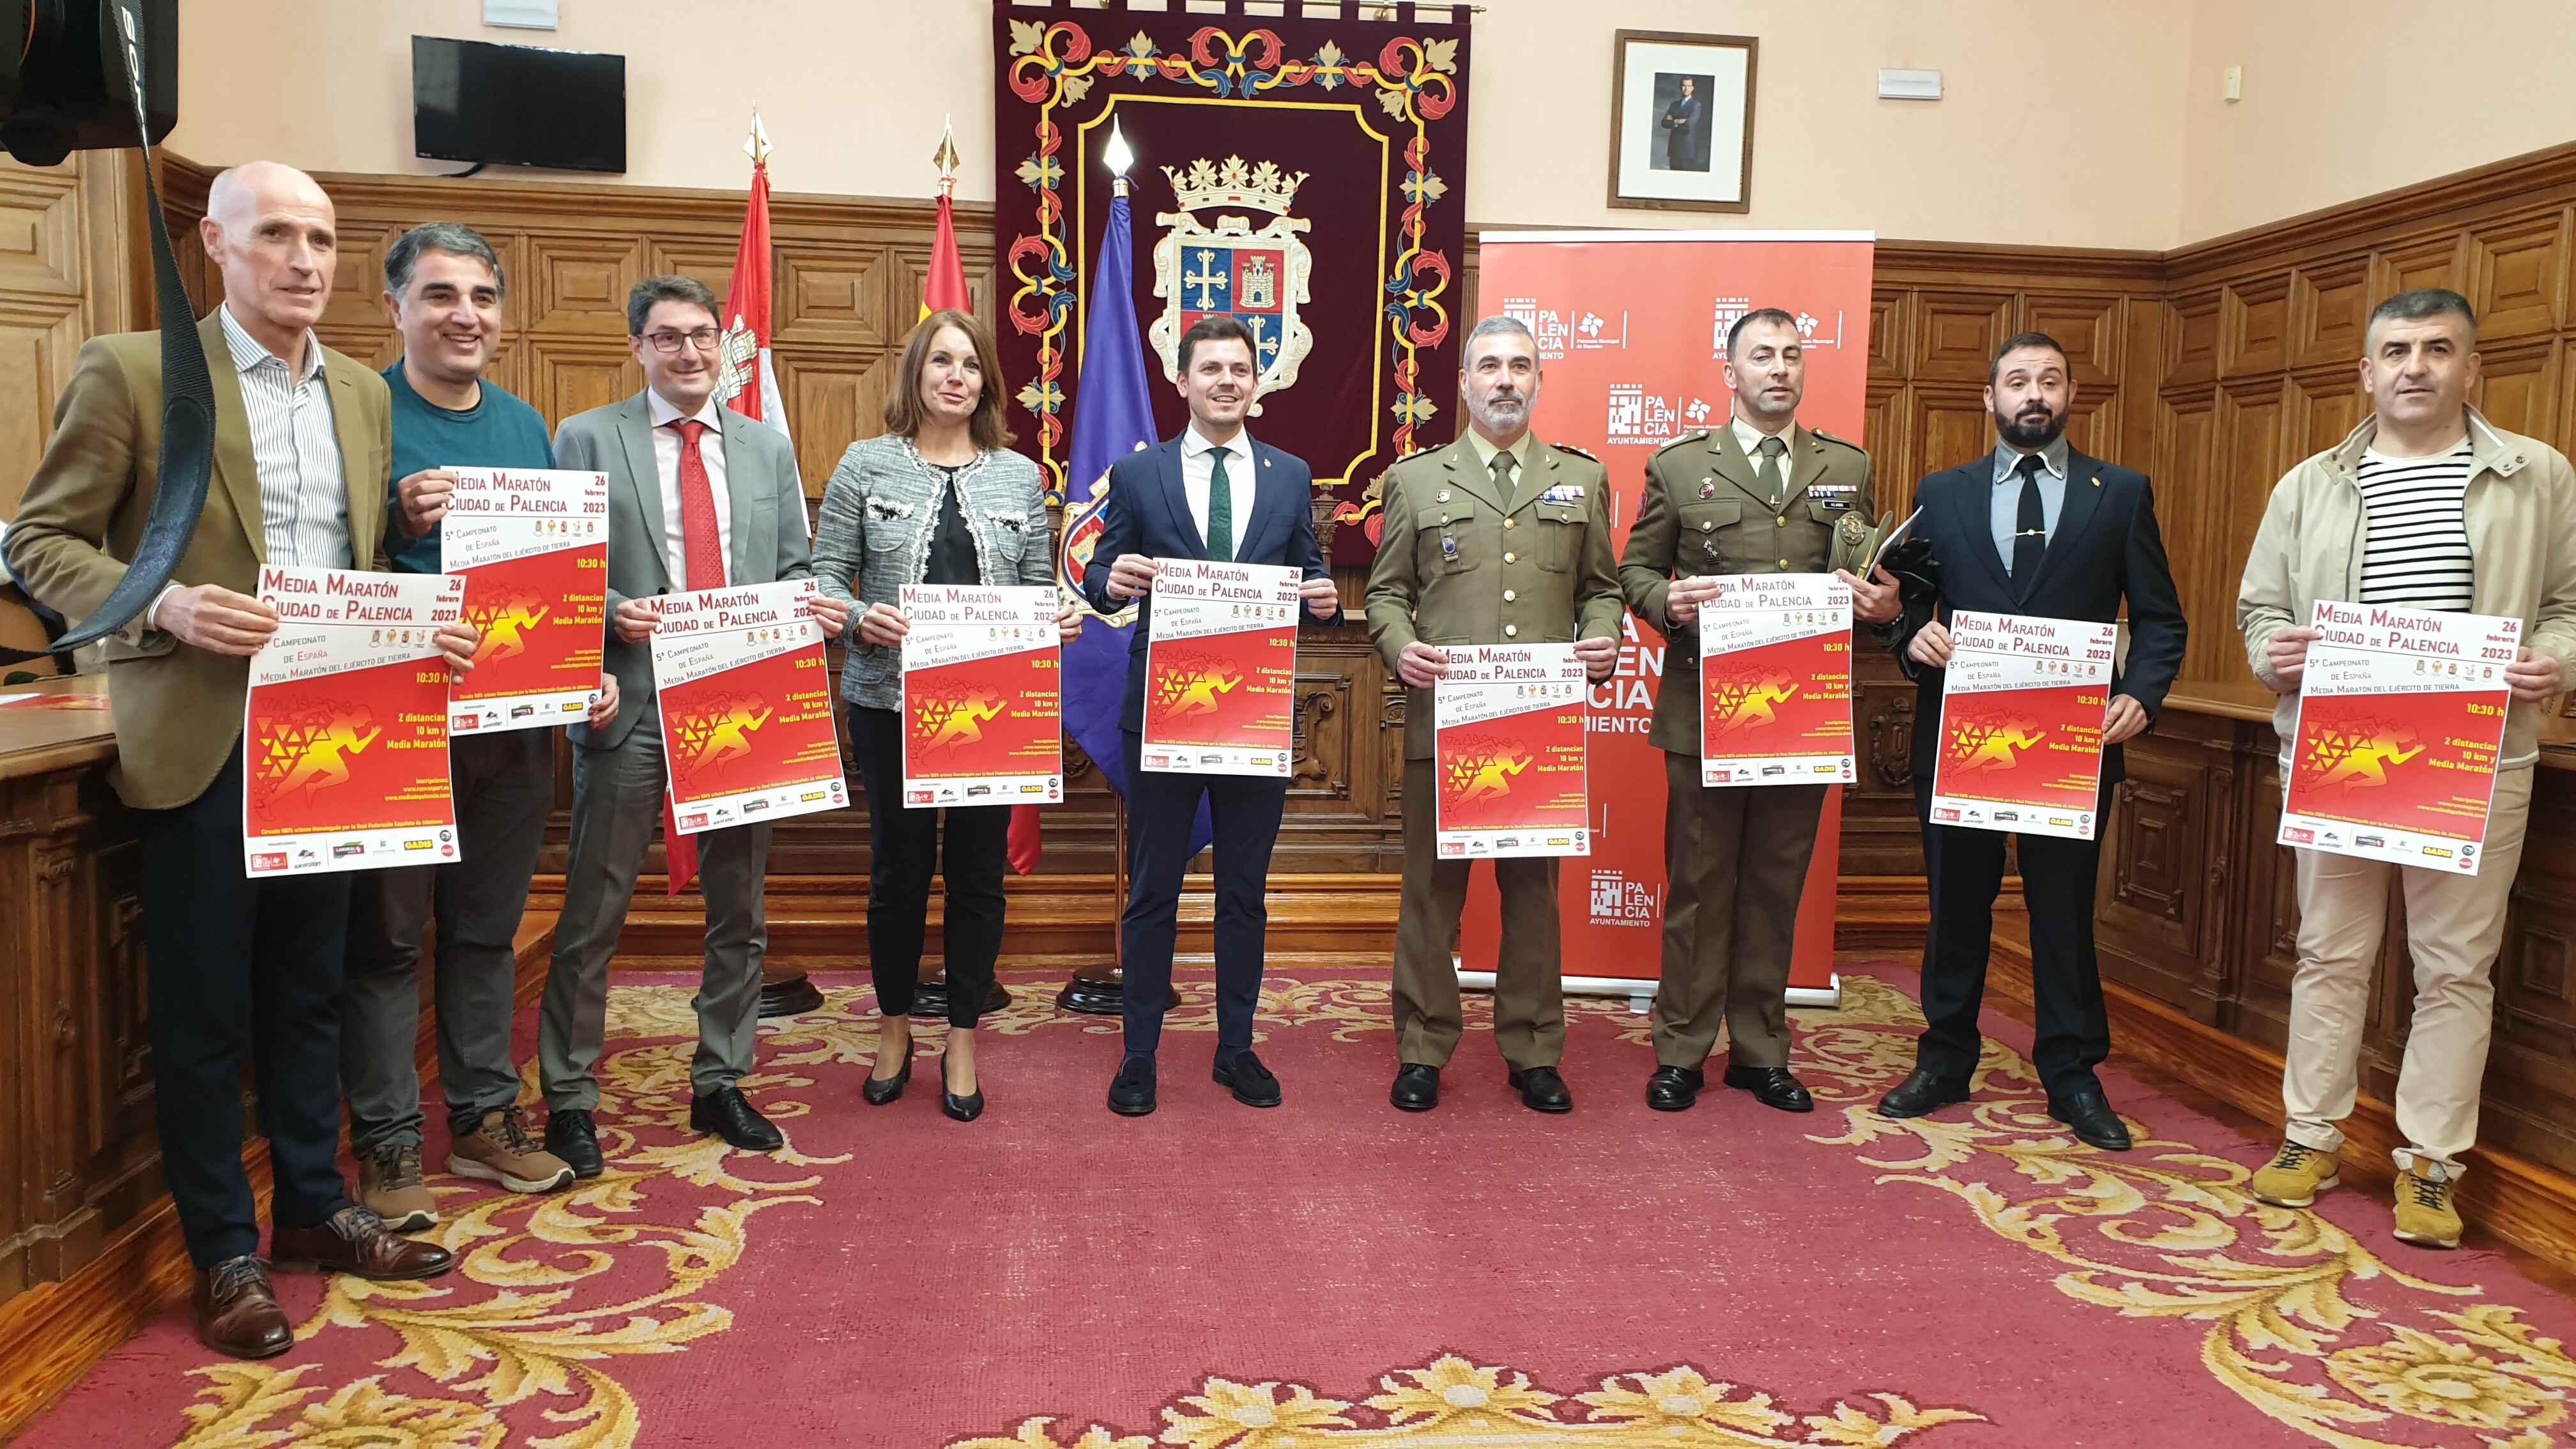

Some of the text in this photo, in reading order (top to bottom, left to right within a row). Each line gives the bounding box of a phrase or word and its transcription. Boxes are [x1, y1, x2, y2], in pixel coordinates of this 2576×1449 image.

[1538, 310, 1559, 323] PA
[1538, 323, 1568, 337] LEN
[1537, 337, 1564, 350] CIA
[1645, 396, 1666, 409] PA
[1644, 410, 1675, 422] LEN
[1643, 422, 1671, 436] CIA
[493, 472, 550, 492] MARATÓN
[595, 475, 605, 486] 26
[495, 503, 505, 511] DE
[510, 494, 567, 512] PALENCIA
[583, 502, 605, 513] 2023
[456, 526, 496, 539] CAMPEONATO
[475, 539, 500, 549] ESPAÑA
[577, 558, 597, 568] 10:30
[1197, 564, 1248, 581] MARATÓN
[1289, 570, 1299, 579] 26
[265, 569, 399, 598] MEDIA MARATÓN
[449, 579, 461, 591] 26
[804, 581, 815, 592] 26
[1742, 578, 1795, 592] MARATÓN
[903, 588, 1001, 603] MEDIA MARATÓN
[1044, 590, 1054, 598] 26
[1212, 583, 1262, 599] PALENCIA
[1276, 592, 1297, 601] 2023
[569, 594, 601, 602] distancias
[1759, 594, 1812, 607] PALENCIA
[1827, 595, 1849, 604] 2023
[650, 592, 759, 616] MEDIA MARATÓN
[326, 609, 339, 618] DE
[346, 600, 412, 621] PALENCIA
[431, 610, 457, 621] 2023
[965, 606, 1018, 620] PALENCIA
[1164, 607, 1199, 616] CAMPEONATO
[553, 615, 601, 625] Media Maratón
[719, 610, 778, 627] PALENCIA
[2316, 603, 2442, 632] MEDIA MARATÓN
[1713, 619, 1749, 630] CAMPEONATO
[1955, 613, 2055, 638] MEDIA MARATÓN
[2502, 621, 2517, 632] 26
[1730, 629, 1752, 638] ESPAÑA
[2102, 627, 2113, 636] 26
[274, 635, 326, 648] CAMPEONATO
[916, 632, 953, 643] CAMPEONATO
[1269, 638, 1287, 647] 10:30
[2370, 638, 2382, 647] DE
[2388, 631, 2459, 654] PALENCIA
[2486, 634, 2515, 643] febrero
[668, 642, 709, 658] CAMPEONATO
[934, 644, 957, 652] ESPAÑA
[1823, 643, 1842, 651] 10:30
[2013, 637, 2069, 656] PALENCIA
[298, 650, 327, 661] ESPAÑA
[1479, 648, 1531, 663] MARATÓN
[2086, 649, 2111, 659] 2023
[2481, 647, 2512, 660] 2023
[688, 654, 714, 666] ESPAÑA
[795, 658, 816, 668] 10:30
[1031, 659, 1051, 668] 10:30
[2322, 659, 2369, 667] CAMPEONATO
[1261, 667, 1292, 675] distancias
[1495, 665, 1546, 679] PALENCIA
[1561, 668, 1583, 677] 2023
[2343, 671, 2372, 680] ESPAÑA
[417, 672, 440, 683] 10:30
[792, 690, 827, 700] distancias
[1266, 686, 1292, 694] Maratón
[1587, 679, 1653, 710] CIA
[1448, 691, 1483, 702] CAMPEONATO
[2077, 695, 2098, 705] 10:30
[1464, 702, 1486, 710] ESPAÑA
[2467, 703, 2494, 716] 10:30
[405, 713, 447, 723] distancias
[779, 709, 831, 723] Media Maratón
[2066, 724, 2102, 734] distancias
[387, 738, 447, 749] Media Maratón
[2049, 742, 2099, 753] Media Maratón
[2452, 739, 2497, 751] distancias
[2428, 758, 2493, 774] Media Maratón
[1626, 882, 1645, 894] PA
[1625, 894, 1654, 907] LEN
[1625, 906, 1650, 919] CIA
[1590, 917, 1650, 927] AYUNTAMIENTO
